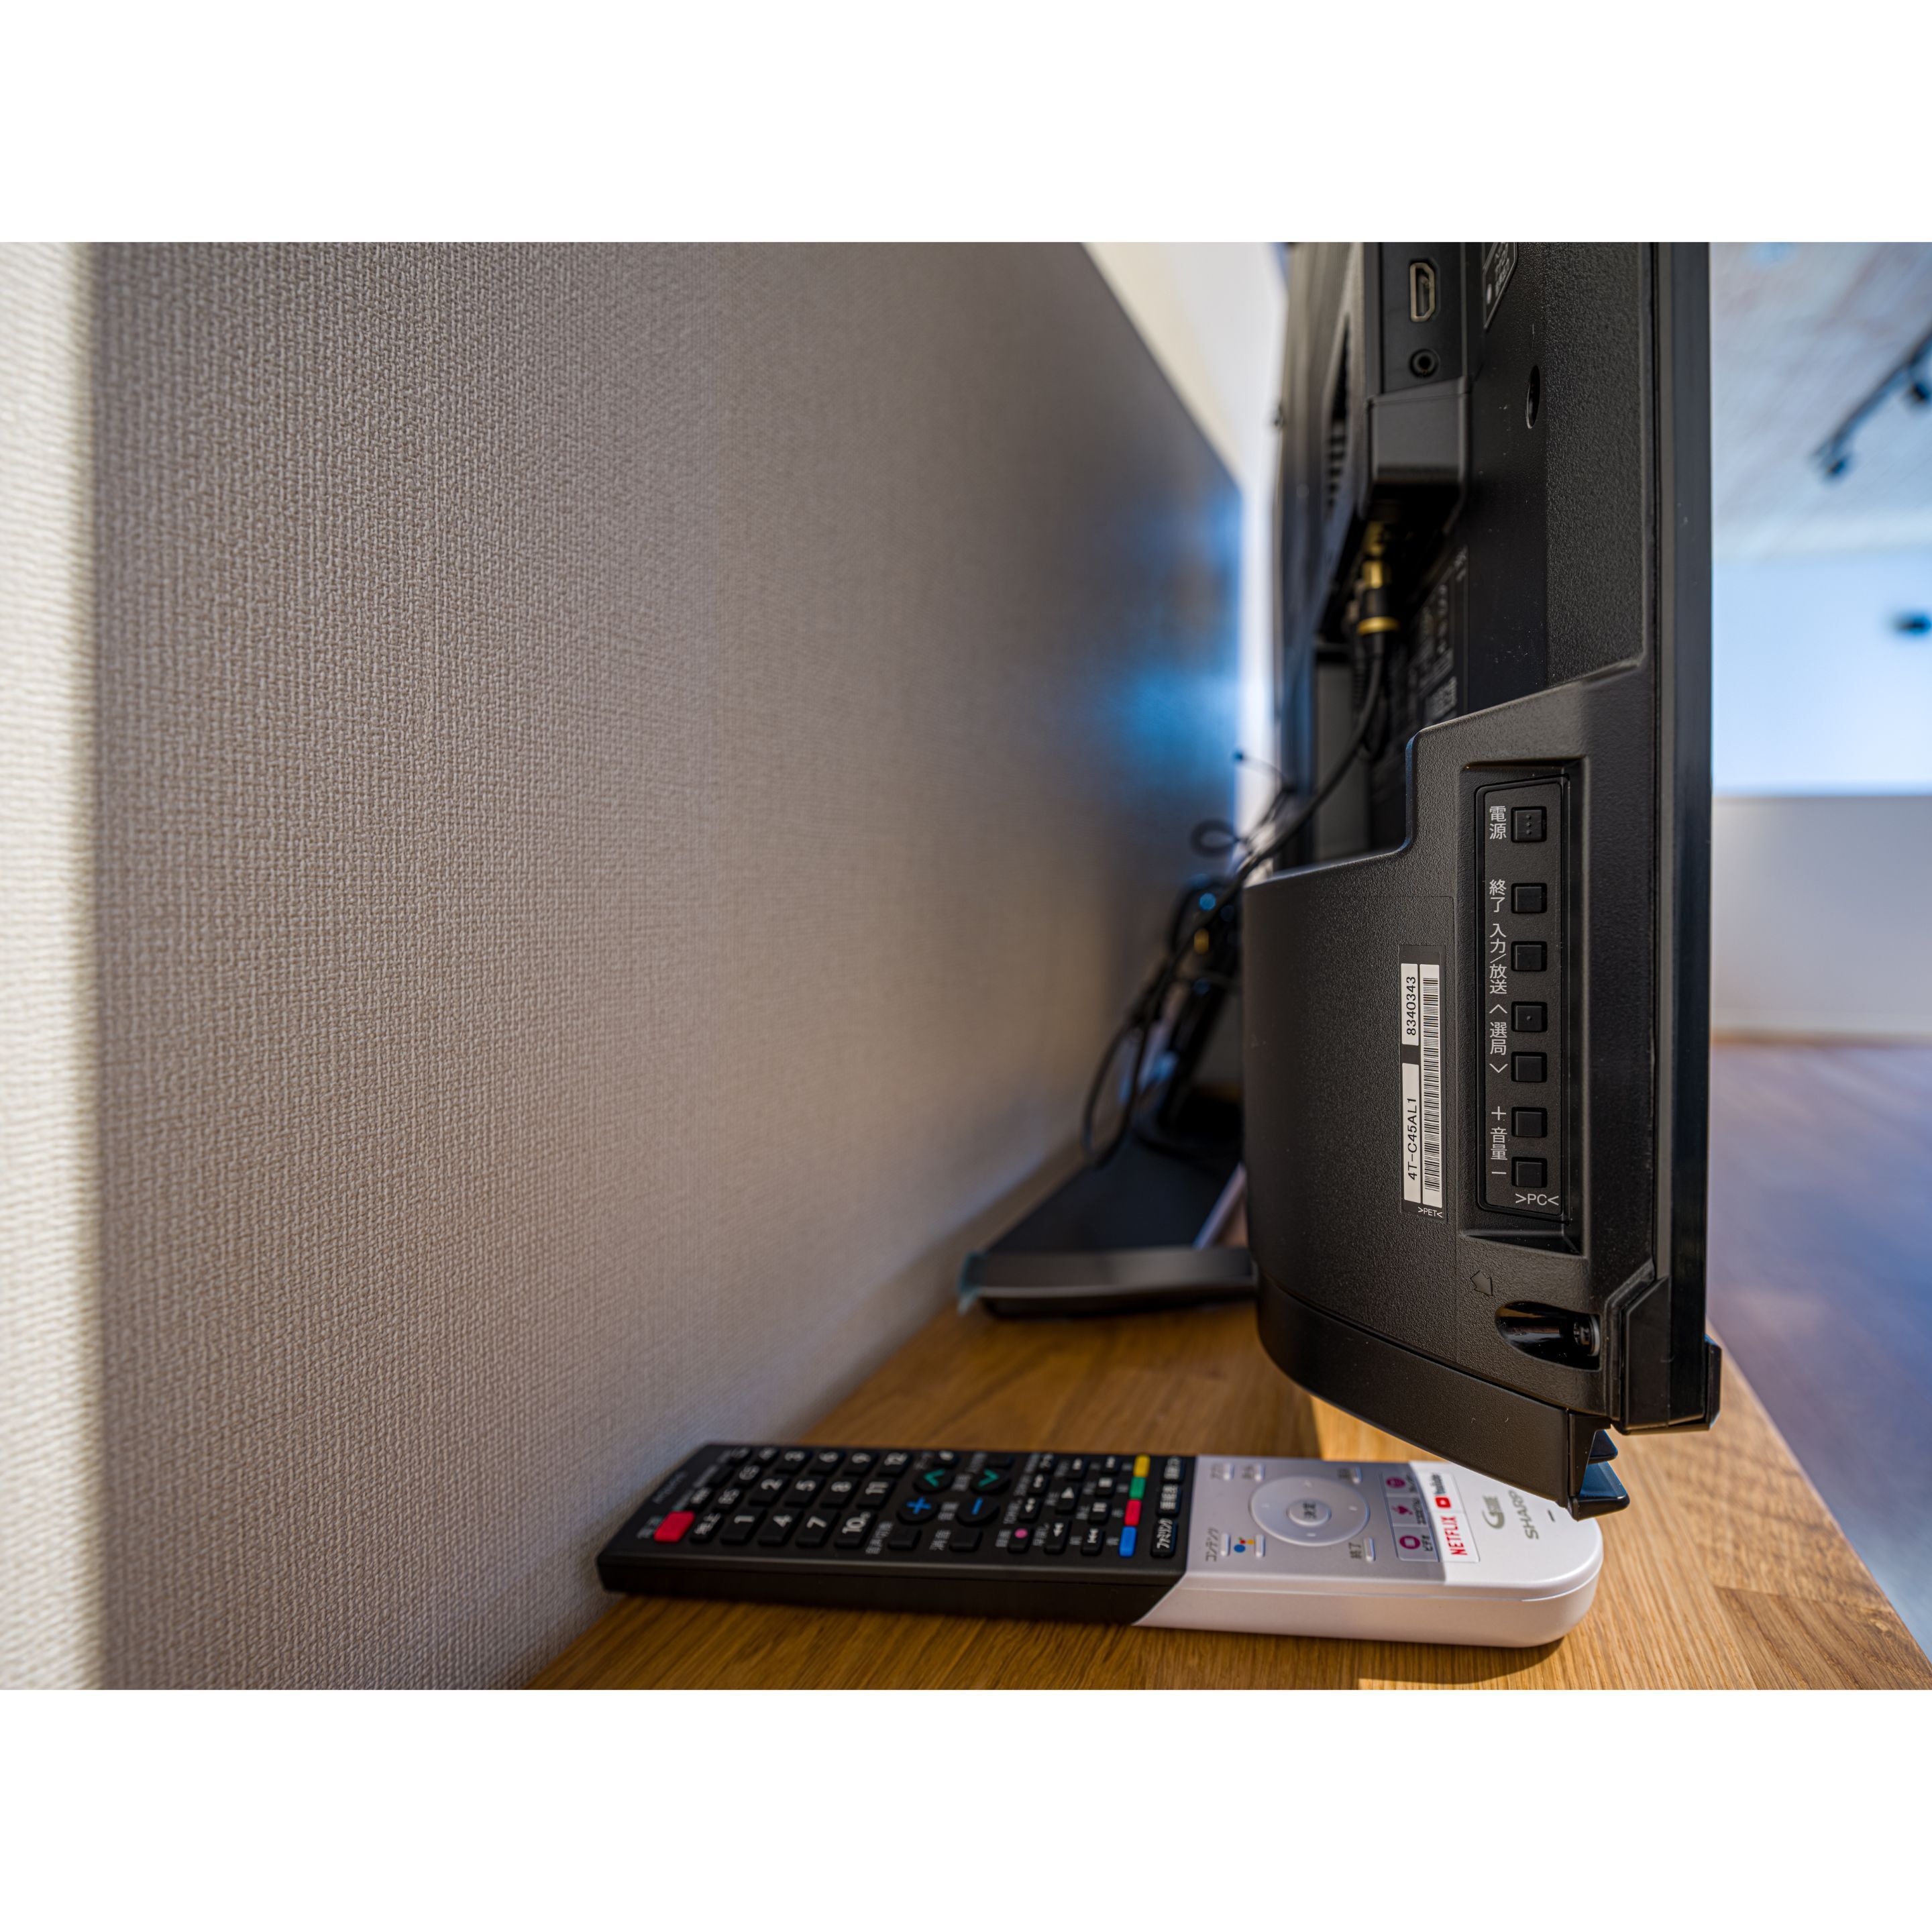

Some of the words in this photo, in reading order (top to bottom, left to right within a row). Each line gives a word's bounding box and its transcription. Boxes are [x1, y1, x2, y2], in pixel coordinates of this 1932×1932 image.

[1489, 806, 1507, 839] 電源
[1489, 879, 1507, 912] 終了
[1489, 924, 1507, 994] 入力/放送
[1406, 976, 1416, 1035] 8340343
[1490, 1022, 1507, 1055] 選局
[1407, 1097, 1417, 1180] 4T-C45AL1
[1491, 1127, 1507, 1160] 音量
[784, 1451, 806, 1461] 3
[819, 1452, 838, 1462] 6
[852, 1453, 871, 1463] 9
[884, 1452, 908, 1466] 12
[761, 1479, 783, 1490] 2
[795, 1480, 816, 1491] 5
[831, 1481, 852, 1492] 8
[865, 1481, 889, 1495] 11
[1304, 1503, 1317, 1519] 決定
[1509, 1490, 1539, 1540] SHARP
[734, 1515, 755, 1524] 1
[773, 1514, 792, 1527] 4
[806, 1515, 826, 1528] 7
[1440, 1516, 1468, 1556] NETFLIX
[1349, 1542, 1362, 1559] 終了
